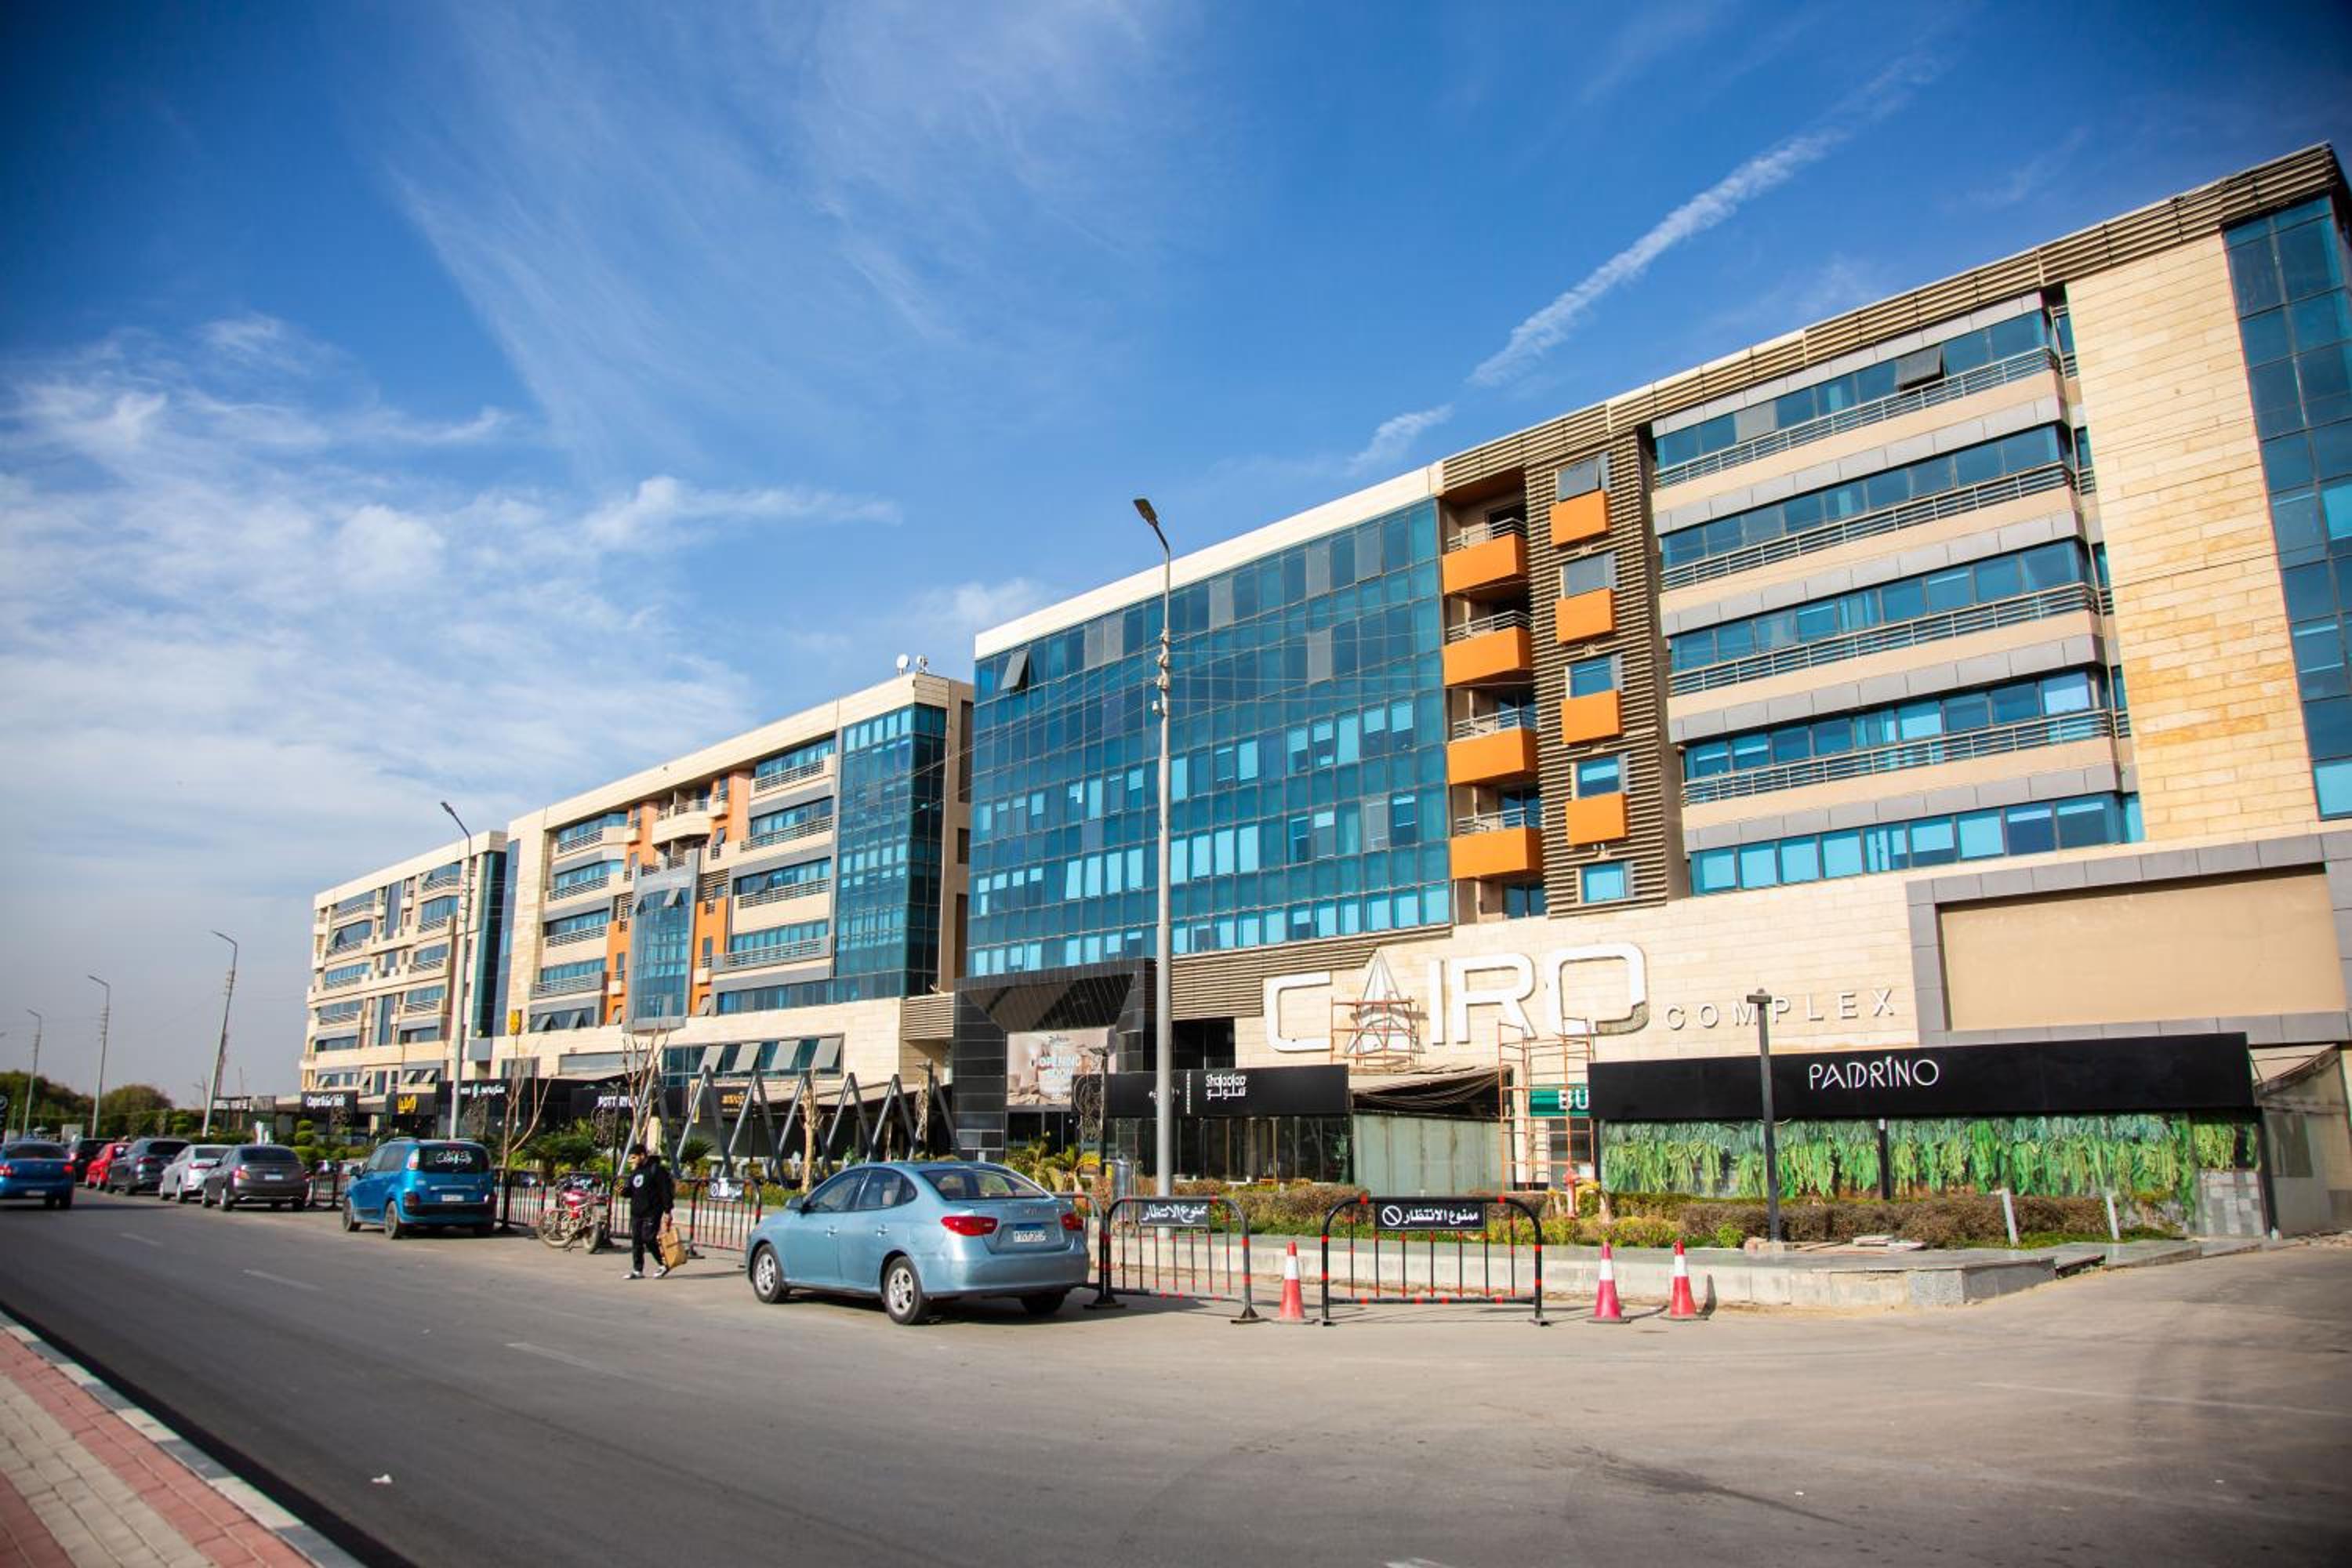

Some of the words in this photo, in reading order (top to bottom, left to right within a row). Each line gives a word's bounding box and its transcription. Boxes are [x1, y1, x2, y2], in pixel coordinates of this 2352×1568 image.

[1264, 941, 1650, 1054] CAIRO
[1666, 988, 1896, 1030] COMPLEX
[1808, 1055, 1940, 1091] PADRINO
[1141, 1203, 1180, 1221] الانتظار
[1180, 1205, 1207, 1224] ممنوع
[1403, 1207, 1448, 1224] الانتظار
[1449, 1208, 1479, 1225] ممنوع
